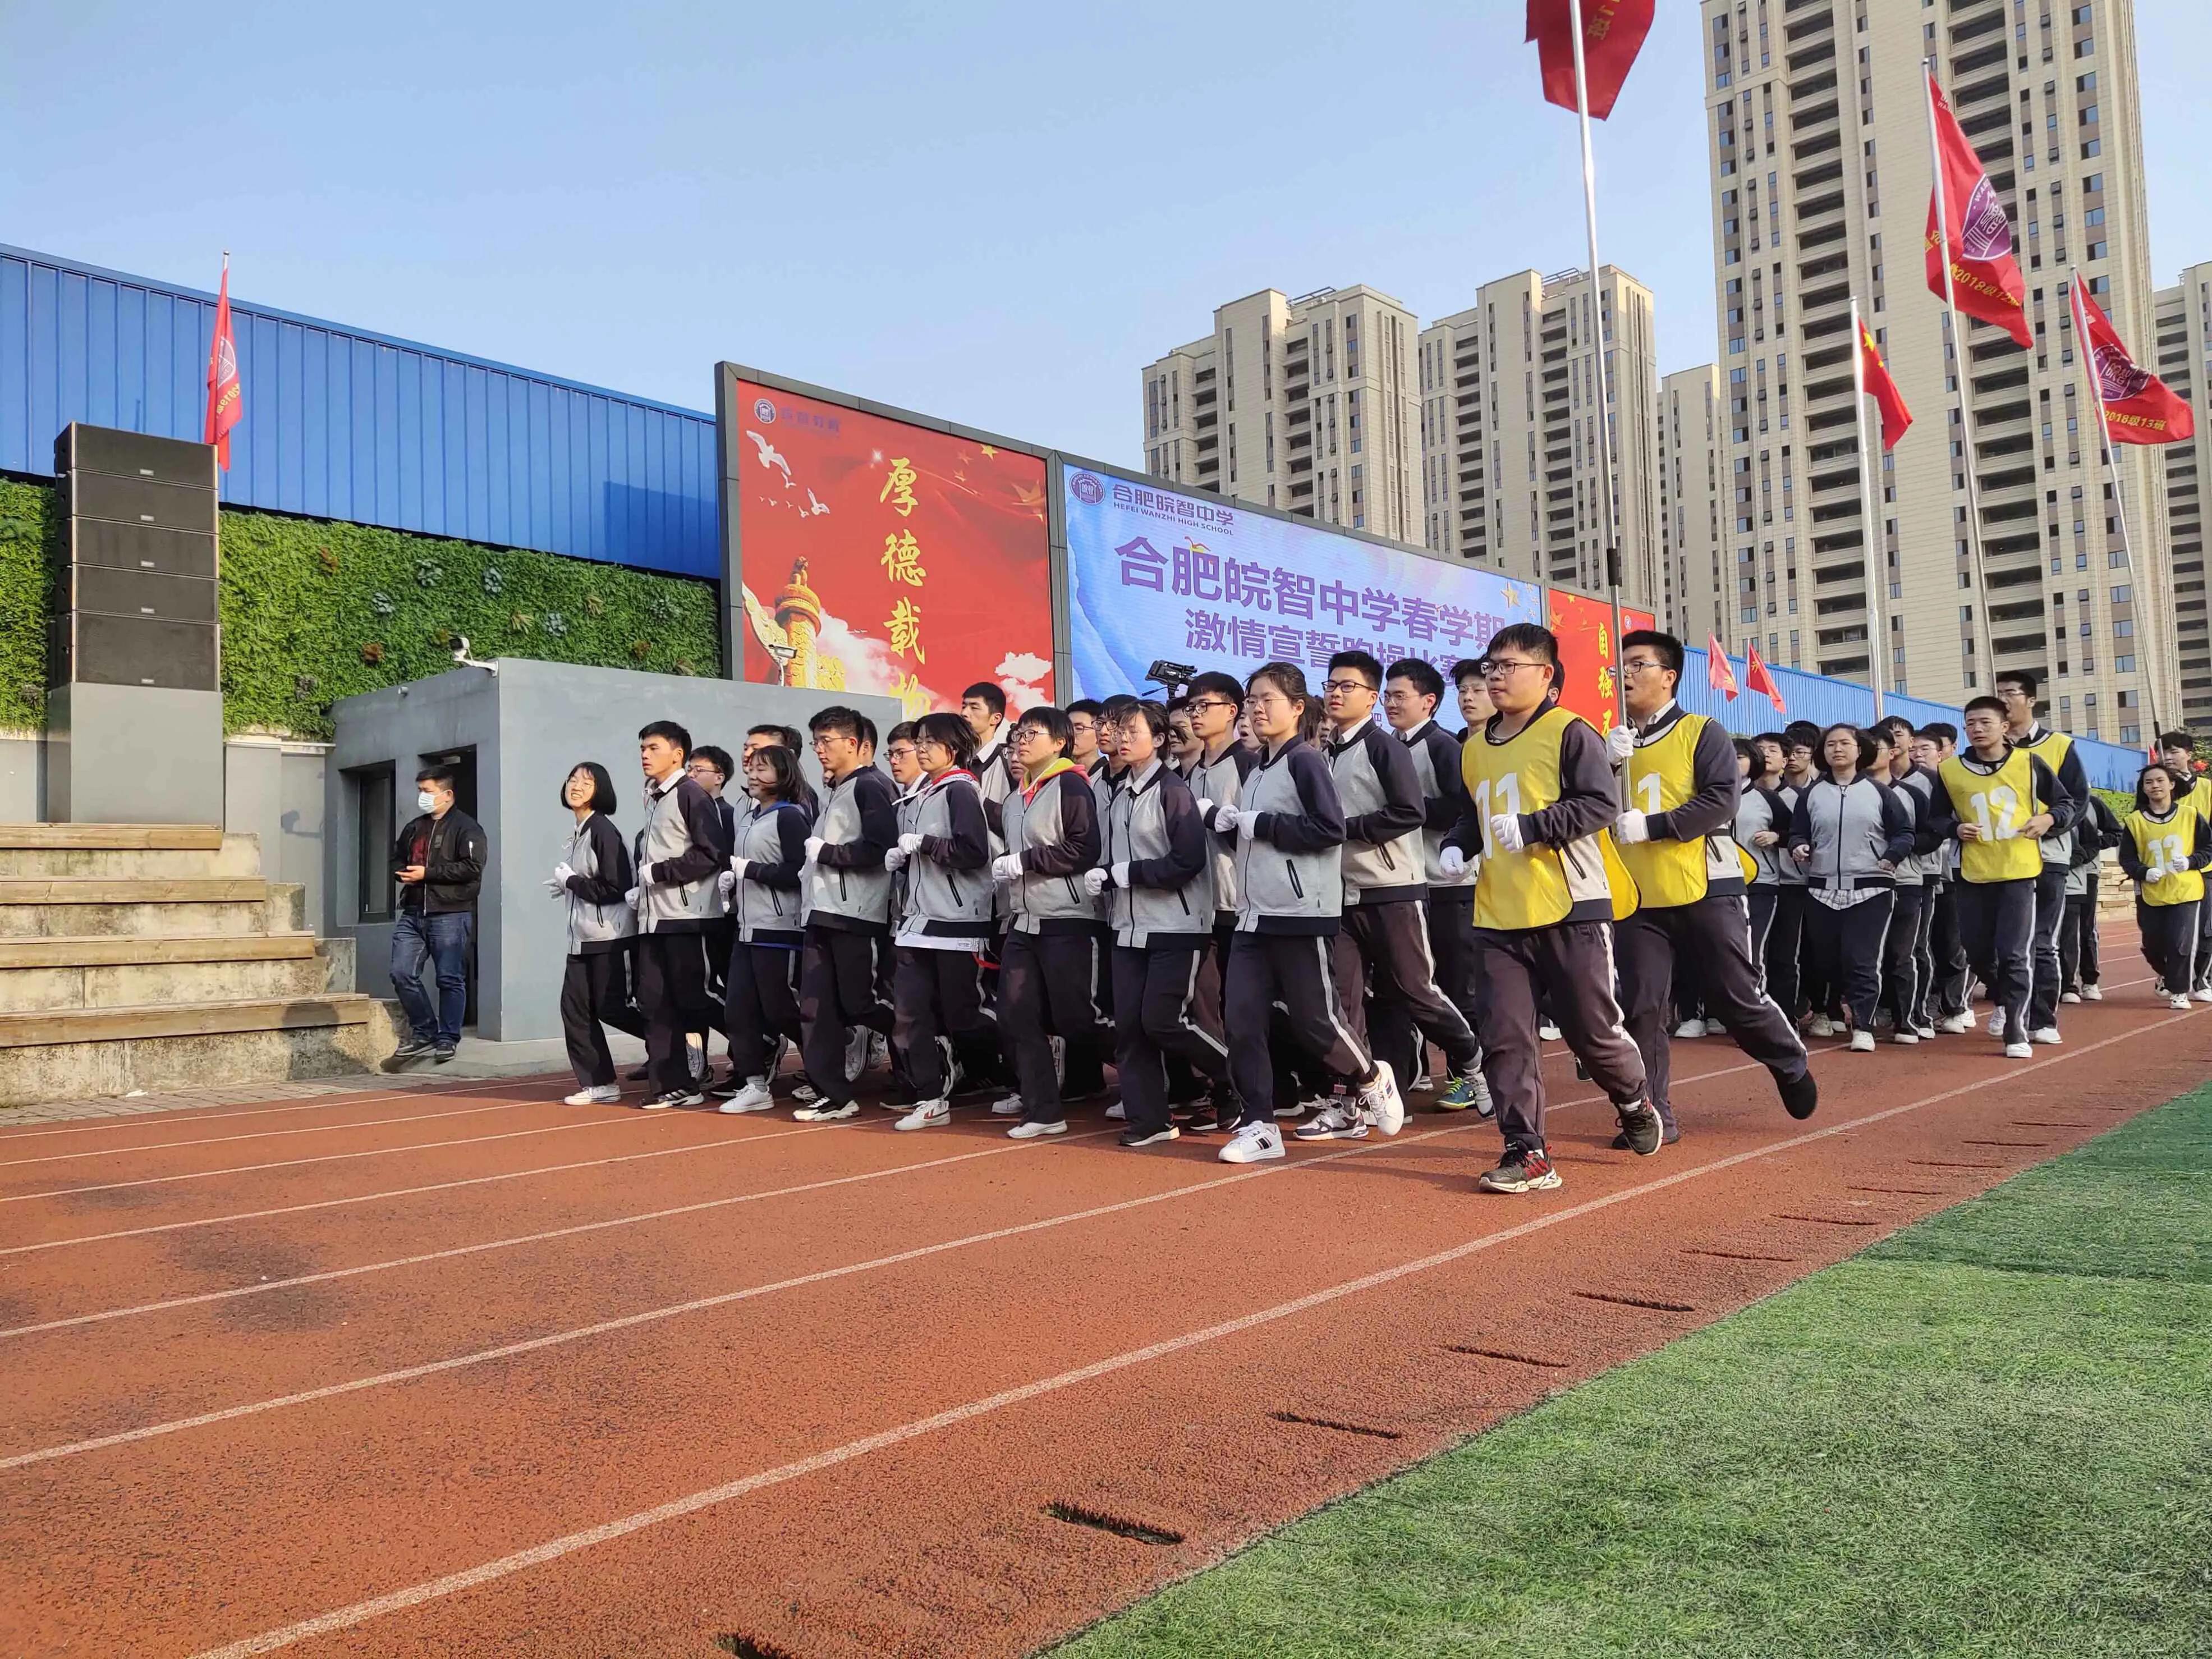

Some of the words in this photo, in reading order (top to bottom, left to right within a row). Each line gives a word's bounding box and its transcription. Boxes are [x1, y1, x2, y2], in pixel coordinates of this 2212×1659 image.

[1113, 484, 1234, 526] 合肥皖智中学
[1114, 502, 1139, 513] HEFEI
[1141, 508, 1176, 521] WANZHI
[1178, 517, 1199, 528] HIGH
[1201, 523, 1234, 536] SCHOOL
[1114, 535, 1505, 650] 合肥皖智中学春学期
[1476, 772, 1520, 859] 11
[1970, 785, 2019, 841] 12
